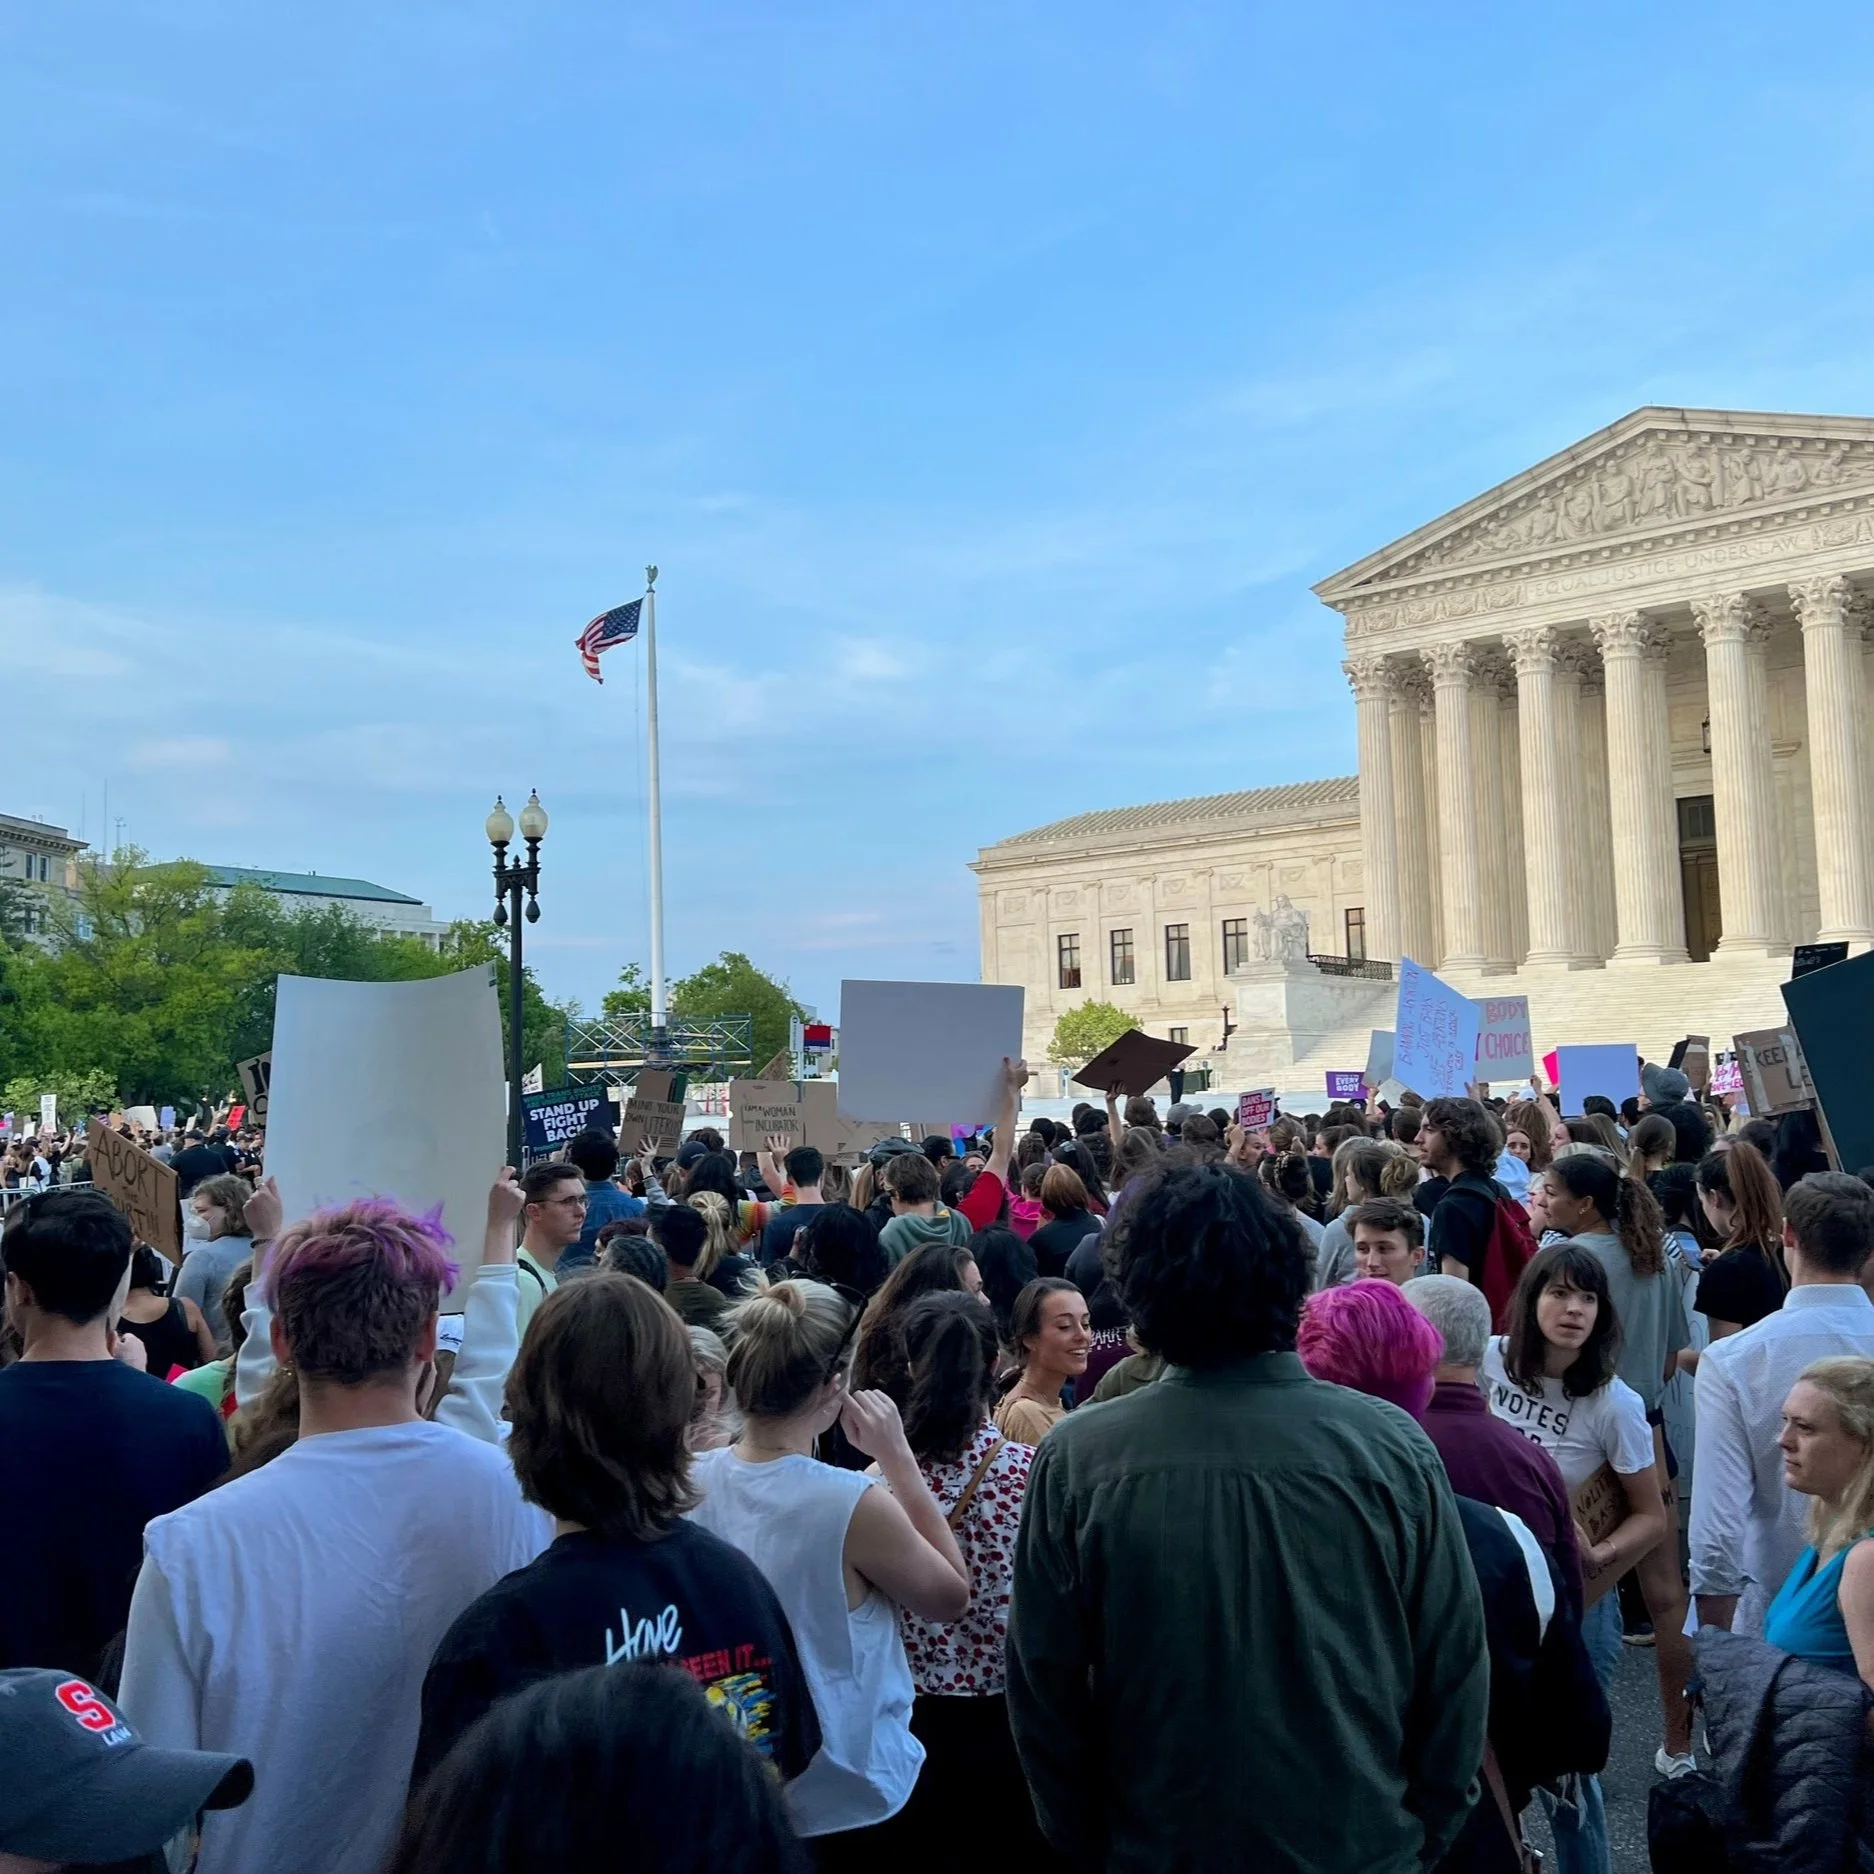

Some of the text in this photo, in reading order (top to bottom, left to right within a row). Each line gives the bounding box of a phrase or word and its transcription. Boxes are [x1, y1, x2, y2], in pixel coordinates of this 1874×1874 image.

[1535, 535, 1799, 597] EQUAL JUSTICE UNDER LAW
[1486, 1001, 1526, 1025] BODY
[1485, 1032, 1529, 1059] CHOICE
[1754, 1046, 1789, 1069] KEE
[1336, 1083, 1359, 1092] BODY
[529, 1099, 600, 1121] STAND UP
[656, 1102, 681, 1115] YOUR
[763, 1106, 796, 1118] WOMAN
[1243, 1112, 1266, 1126] BODIES
[543, 1112, 588, 1131] FIGHT
[755, 1119, 800, 1132] INCUBATOR
[94, 1129, 169, 1208] ABORT
[1498, 1386, 1569, 1436] VOTES
[682, 1648, 732, 1681] EEN
[55, 1679, 117, 1732] S
[102, 1726, 132, 1747] LAW
